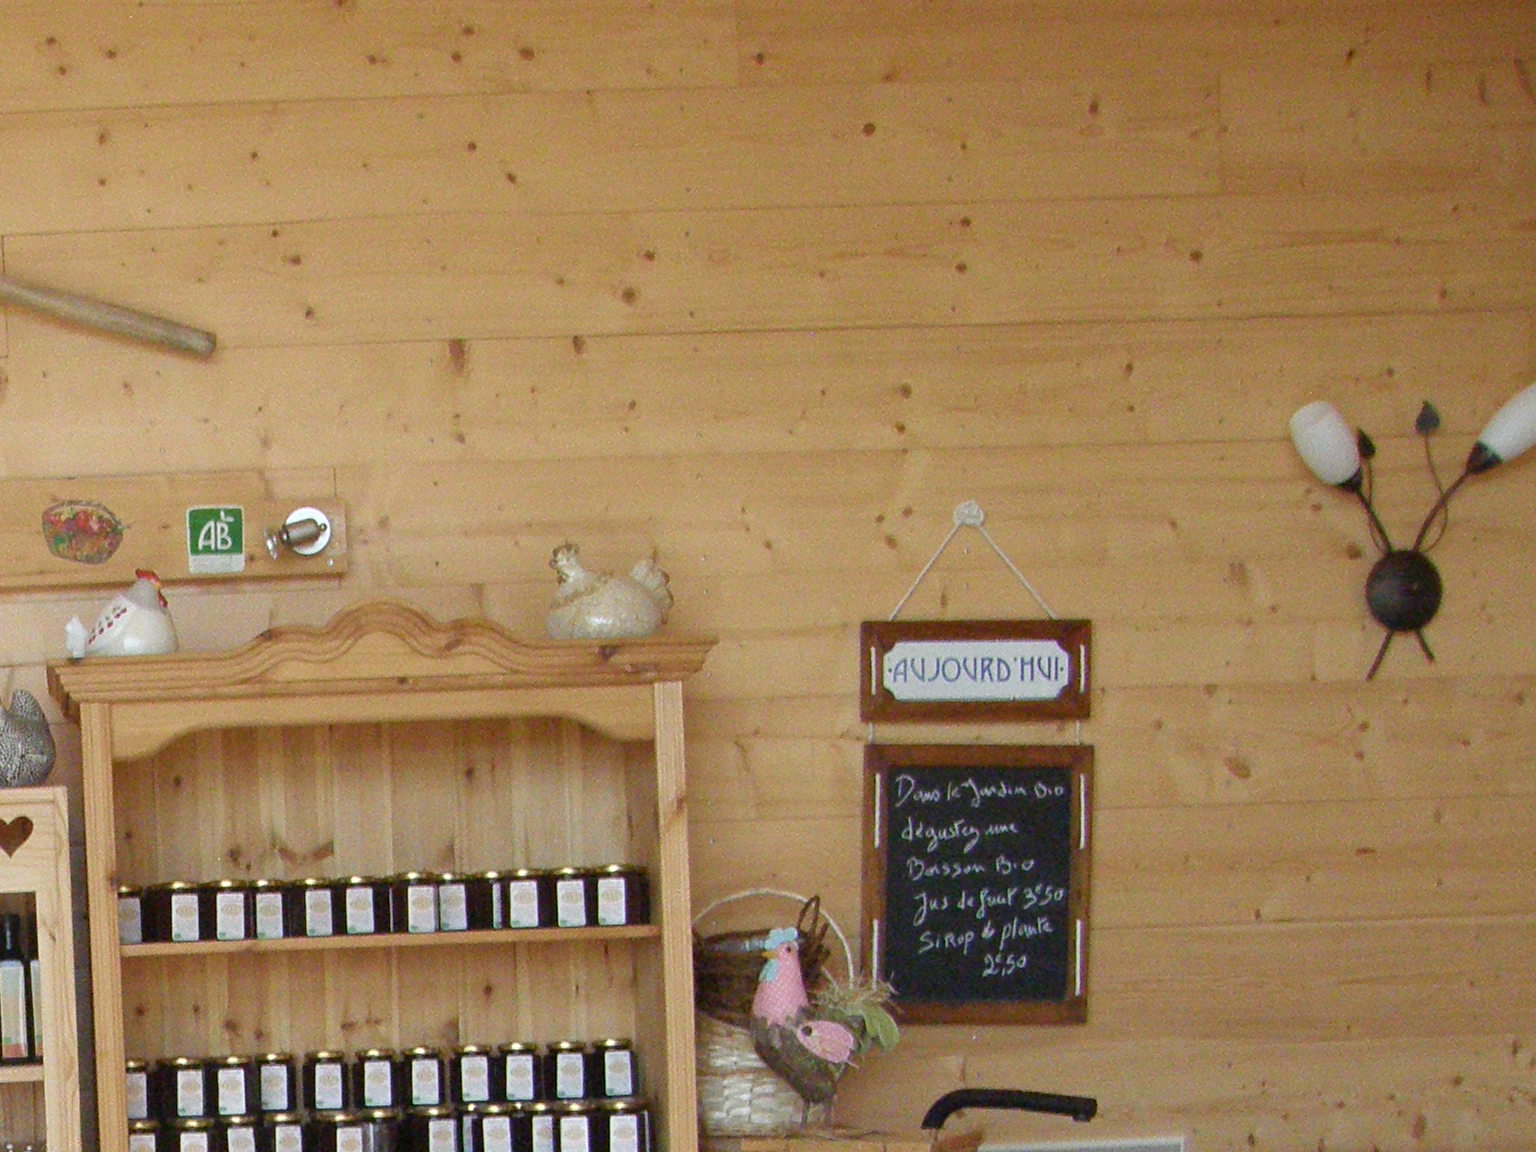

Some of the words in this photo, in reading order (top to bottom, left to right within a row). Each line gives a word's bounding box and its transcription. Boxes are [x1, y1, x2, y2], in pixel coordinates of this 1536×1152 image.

[198, 519, 232, 551] AB
[892, 656, 1059, 683] AUJOURD'HUI
[895, 774, 941, 807] Dans
[913, 890, 949, 927] Jus
